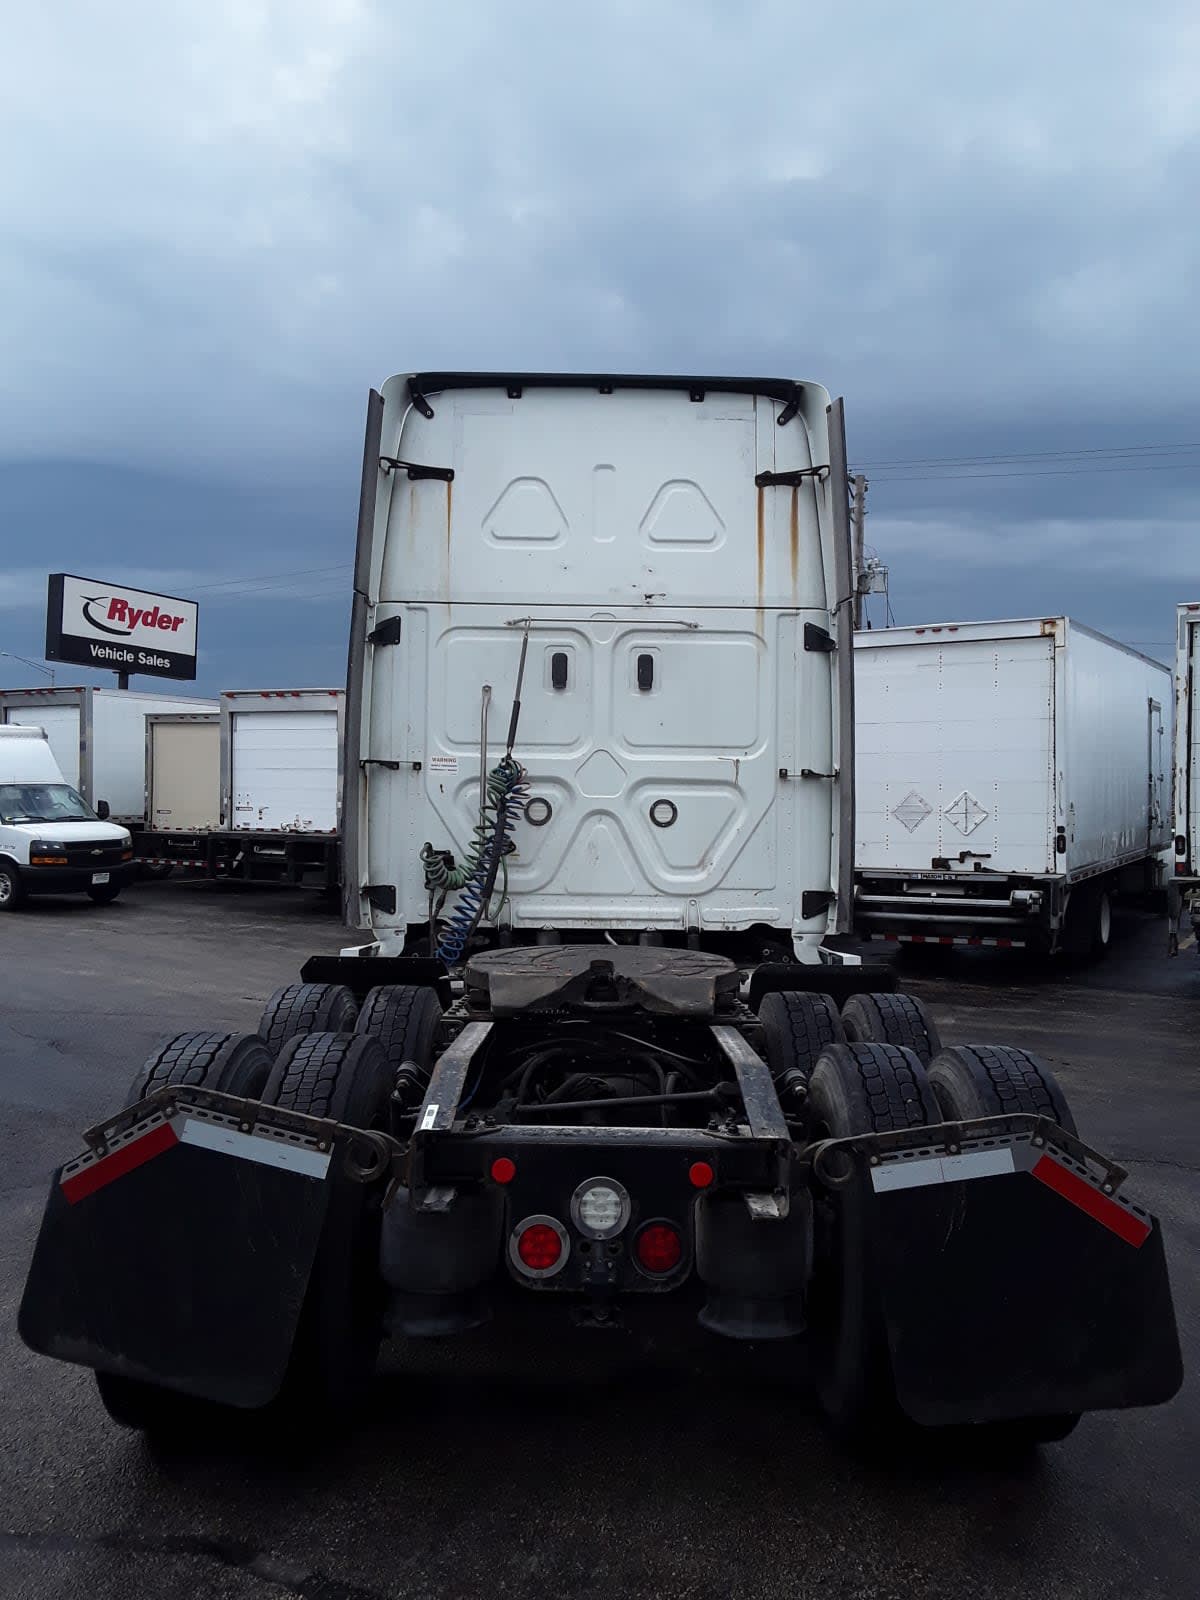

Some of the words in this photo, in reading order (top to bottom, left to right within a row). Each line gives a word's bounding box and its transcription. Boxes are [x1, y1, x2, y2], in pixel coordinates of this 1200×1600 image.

[107, 598, 184, 632] Ryder
[90, 644, 135, 663] Vehicle
[138, 652, 171, 669] Sales
